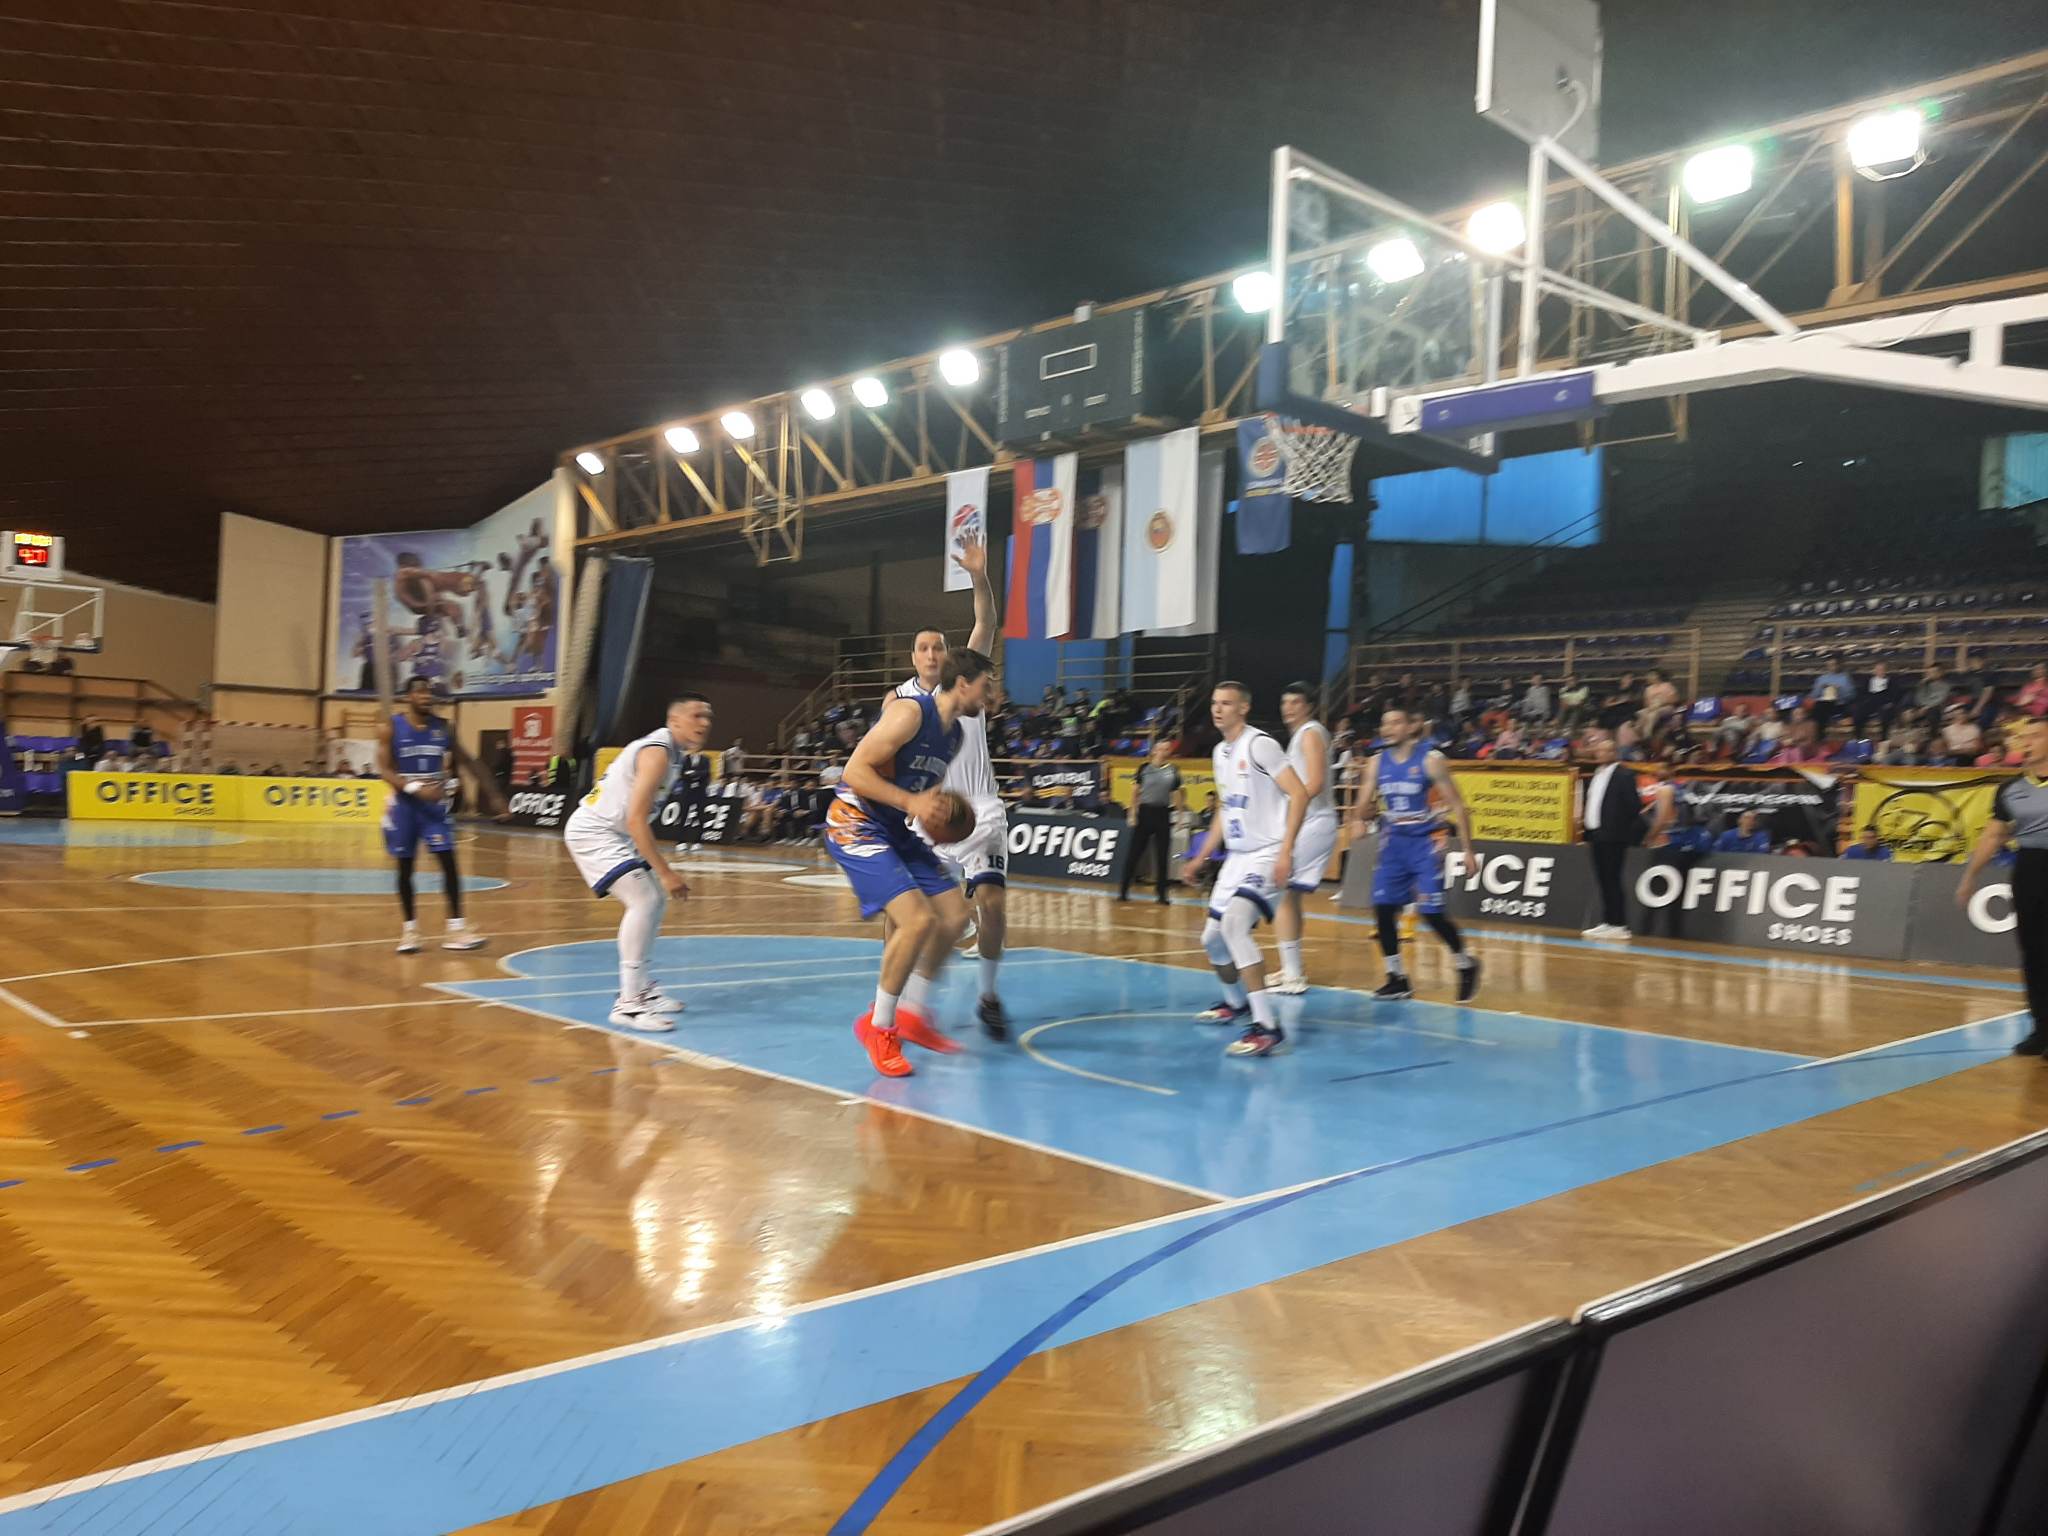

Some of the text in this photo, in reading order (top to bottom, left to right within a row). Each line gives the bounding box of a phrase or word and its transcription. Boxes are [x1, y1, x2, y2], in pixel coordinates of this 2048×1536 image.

[97, 780, 214, 804] OFFICE
[265, 784, 368, 807] OFFICE
[1008, 823, 1119, 861] OFFICE
[988, 853, 1005, 870] 16
[1444, 851, 1555, 898] FICE
[1635, 864, 1861, 922] OFFICE
[1480, 898, 1546, 918] SHOES
[1767, 922, 1852, 946] SHOES
